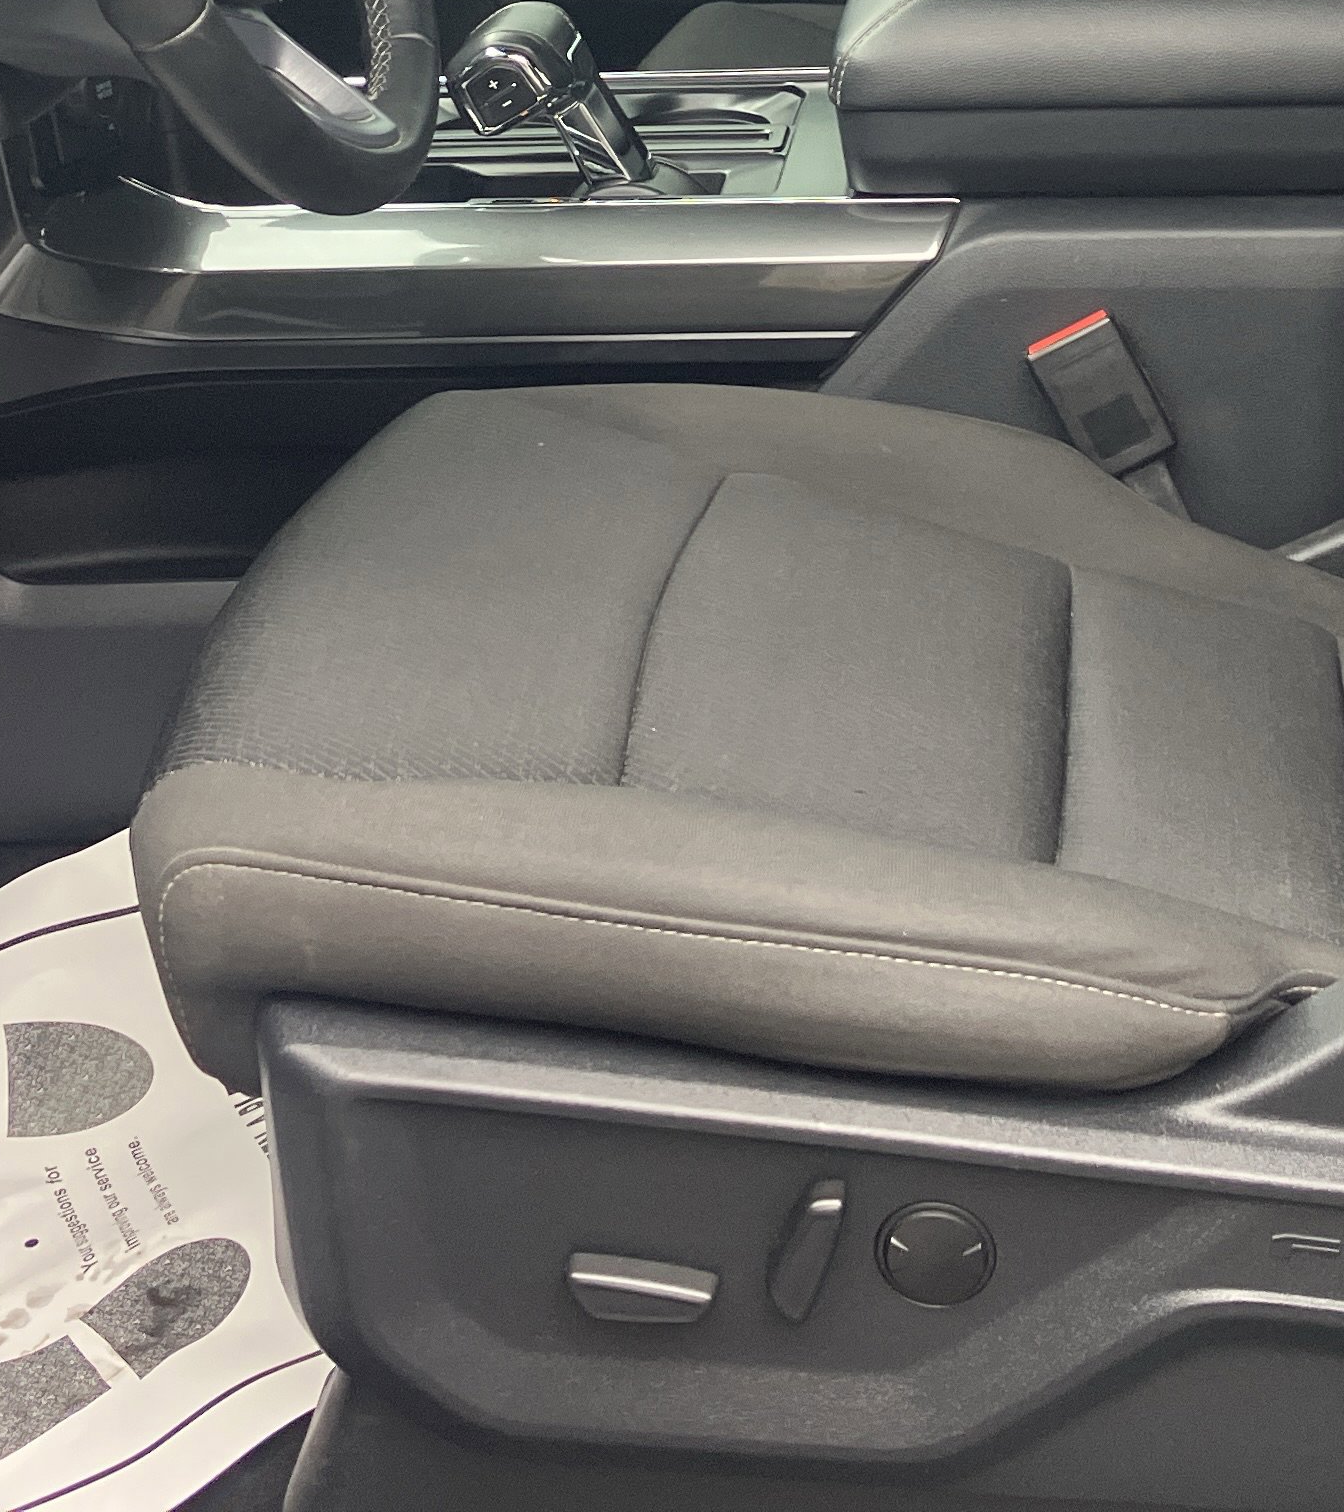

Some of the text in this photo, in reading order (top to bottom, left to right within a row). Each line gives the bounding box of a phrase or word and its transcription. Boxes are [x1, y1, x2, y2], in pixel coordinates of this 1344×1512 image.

[84, 1147, 113, 1192] service
[103, 1192, 120, 1210] our
[127, 1136, 180, 1226] are always welcome.
[44, 1165, 99, 1274] Your suggestions for
